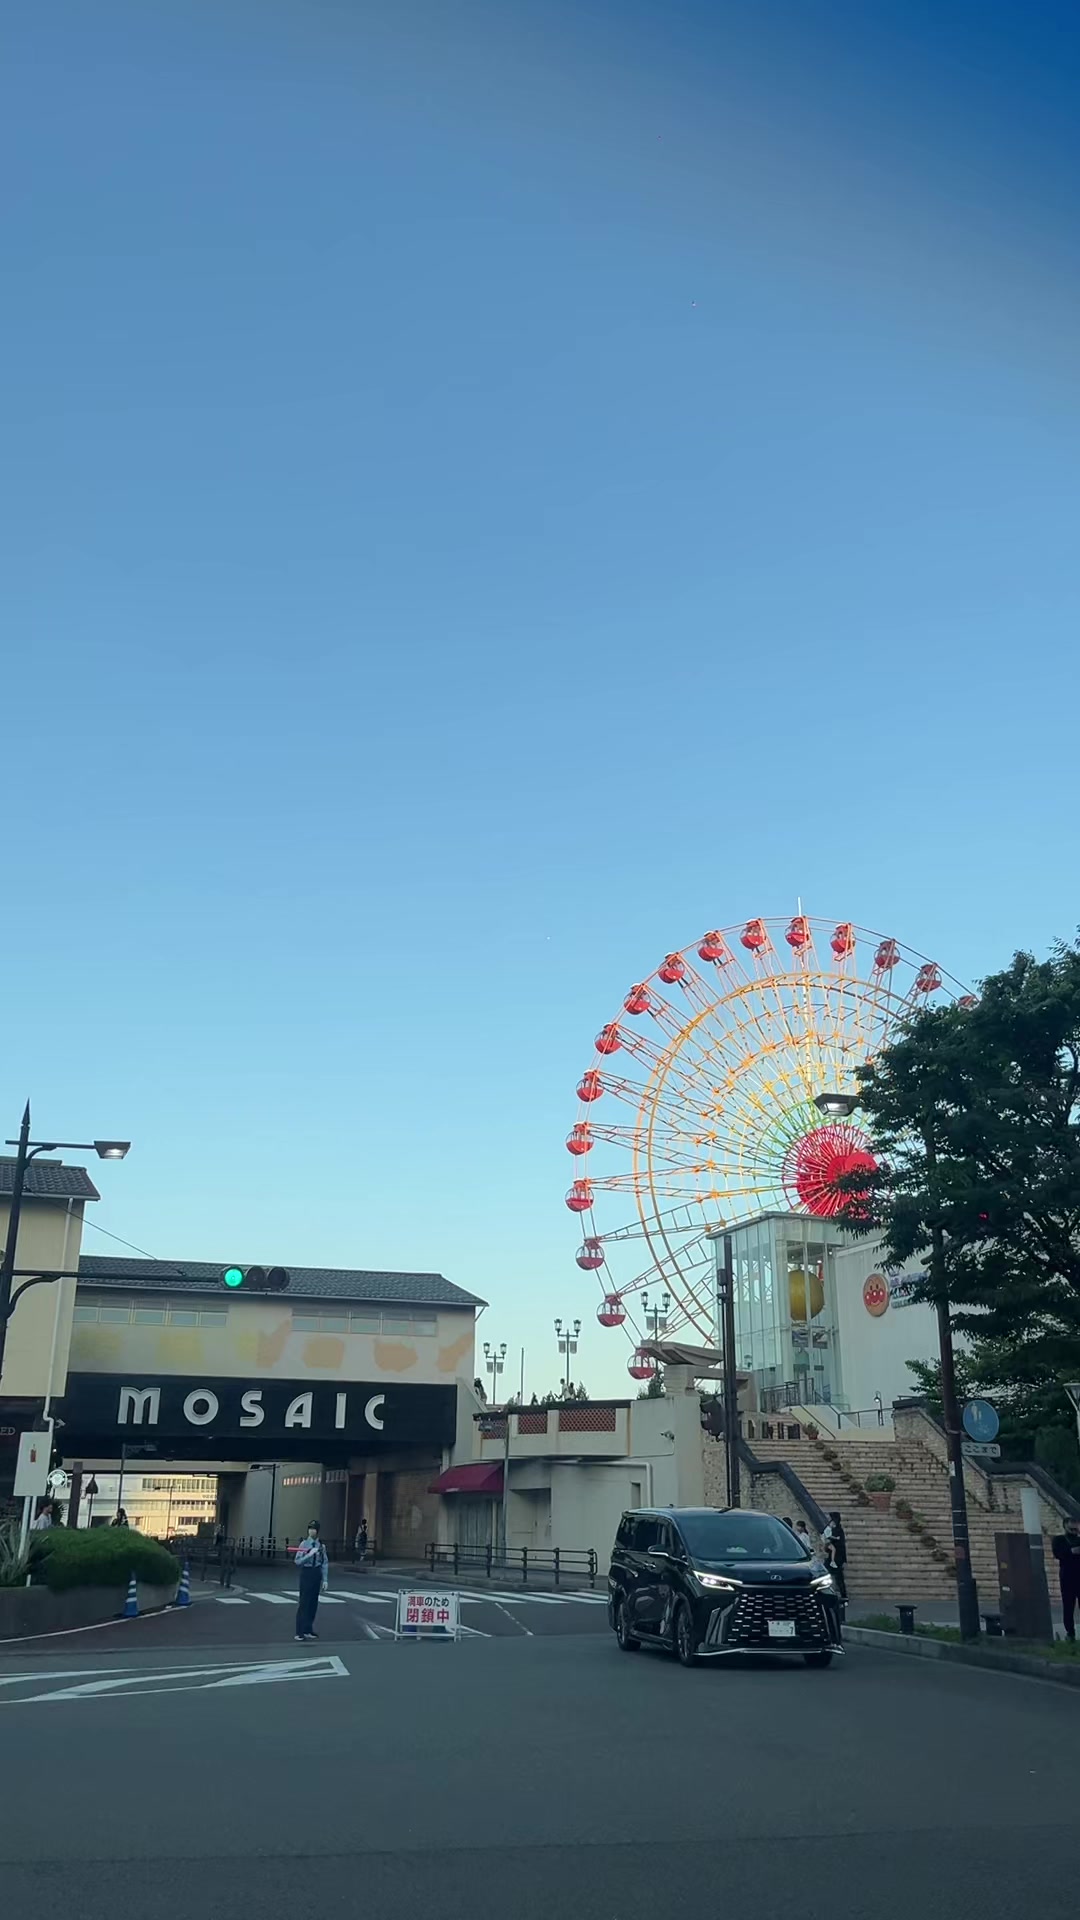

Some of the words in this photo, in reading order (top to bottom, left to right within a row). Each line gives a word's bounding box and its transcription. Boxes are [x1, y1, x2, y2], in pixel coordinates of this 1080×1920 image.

[117, 1386, 386, 1431] MOSAIC
[964, 1444, 998, 1455] ここまで
[406, 1607, 450, 1624] 閉鎖中
